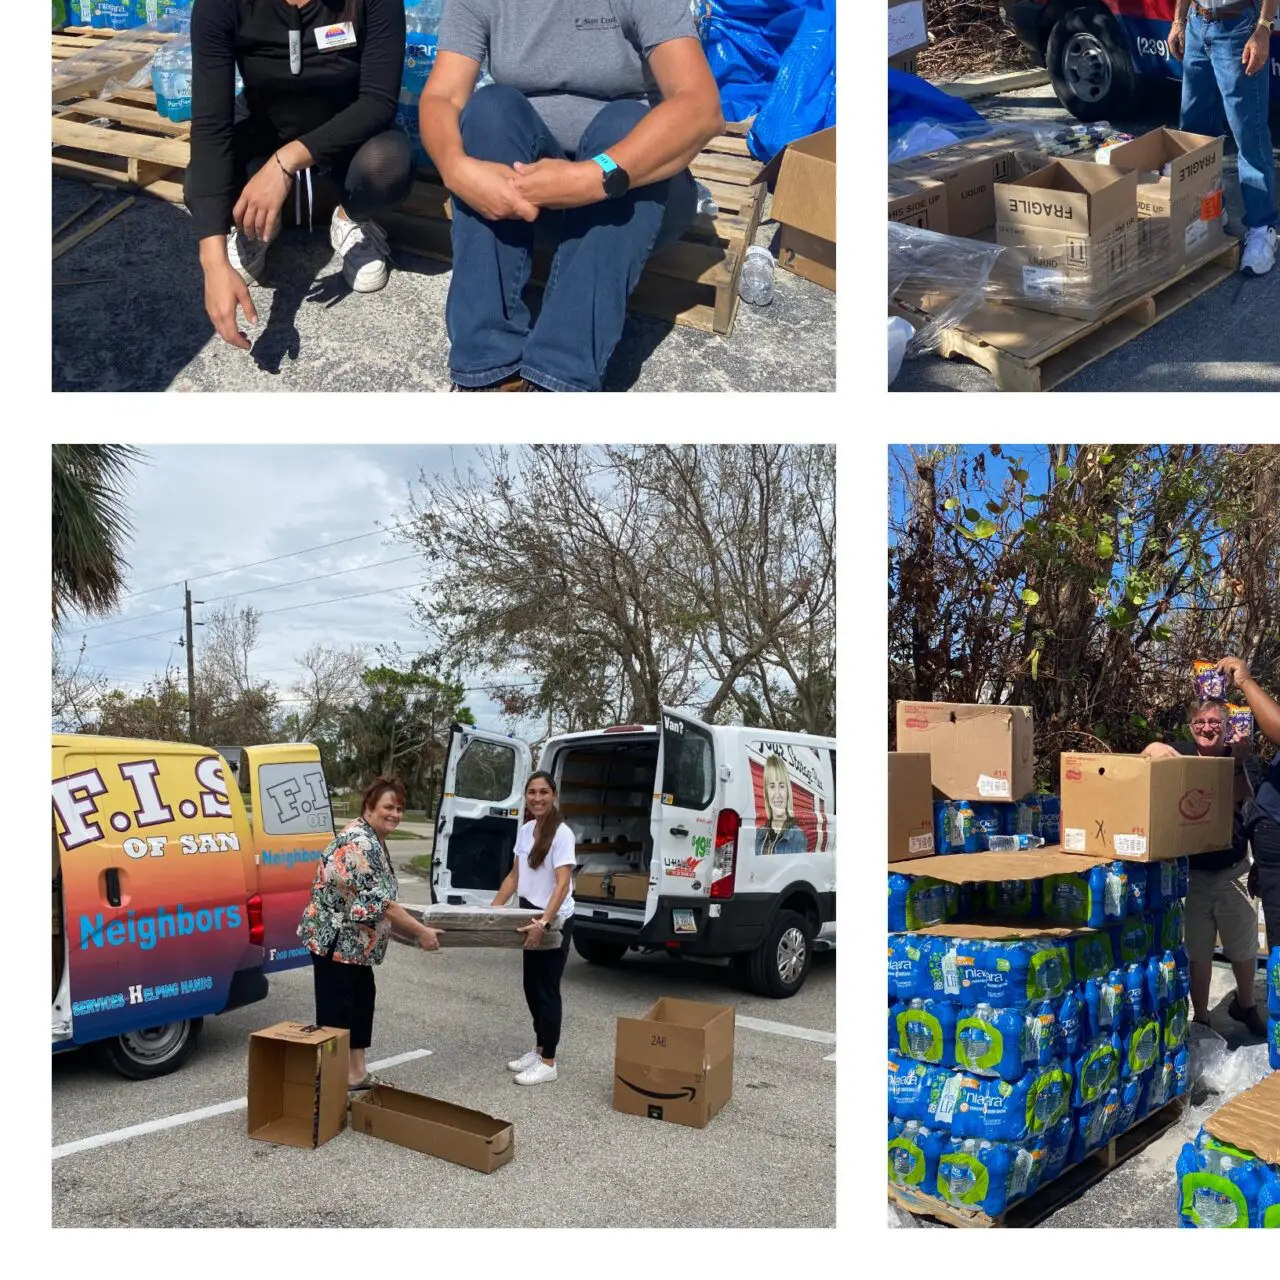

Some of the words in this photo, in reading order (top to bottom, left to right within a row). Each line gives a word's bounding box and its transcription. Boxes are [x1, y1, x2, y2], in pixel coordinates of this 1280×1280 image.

[1179, 151, 1216, 182] FRAGILE
[961, 184, 986, 200] LIQUID
[906, 198, 927, 213] SIDE
[928, 195, 941, 206] UP
[1009, 198, 1073, 221] FRAGILE
[664, 715, 684, 735] Van?
[122, 835, 168, 859] OF
[179, 831, 241, 856] SAN
[79, 903, 242, 951] Neighbors
[181, 975, 213, 995] HANDS
